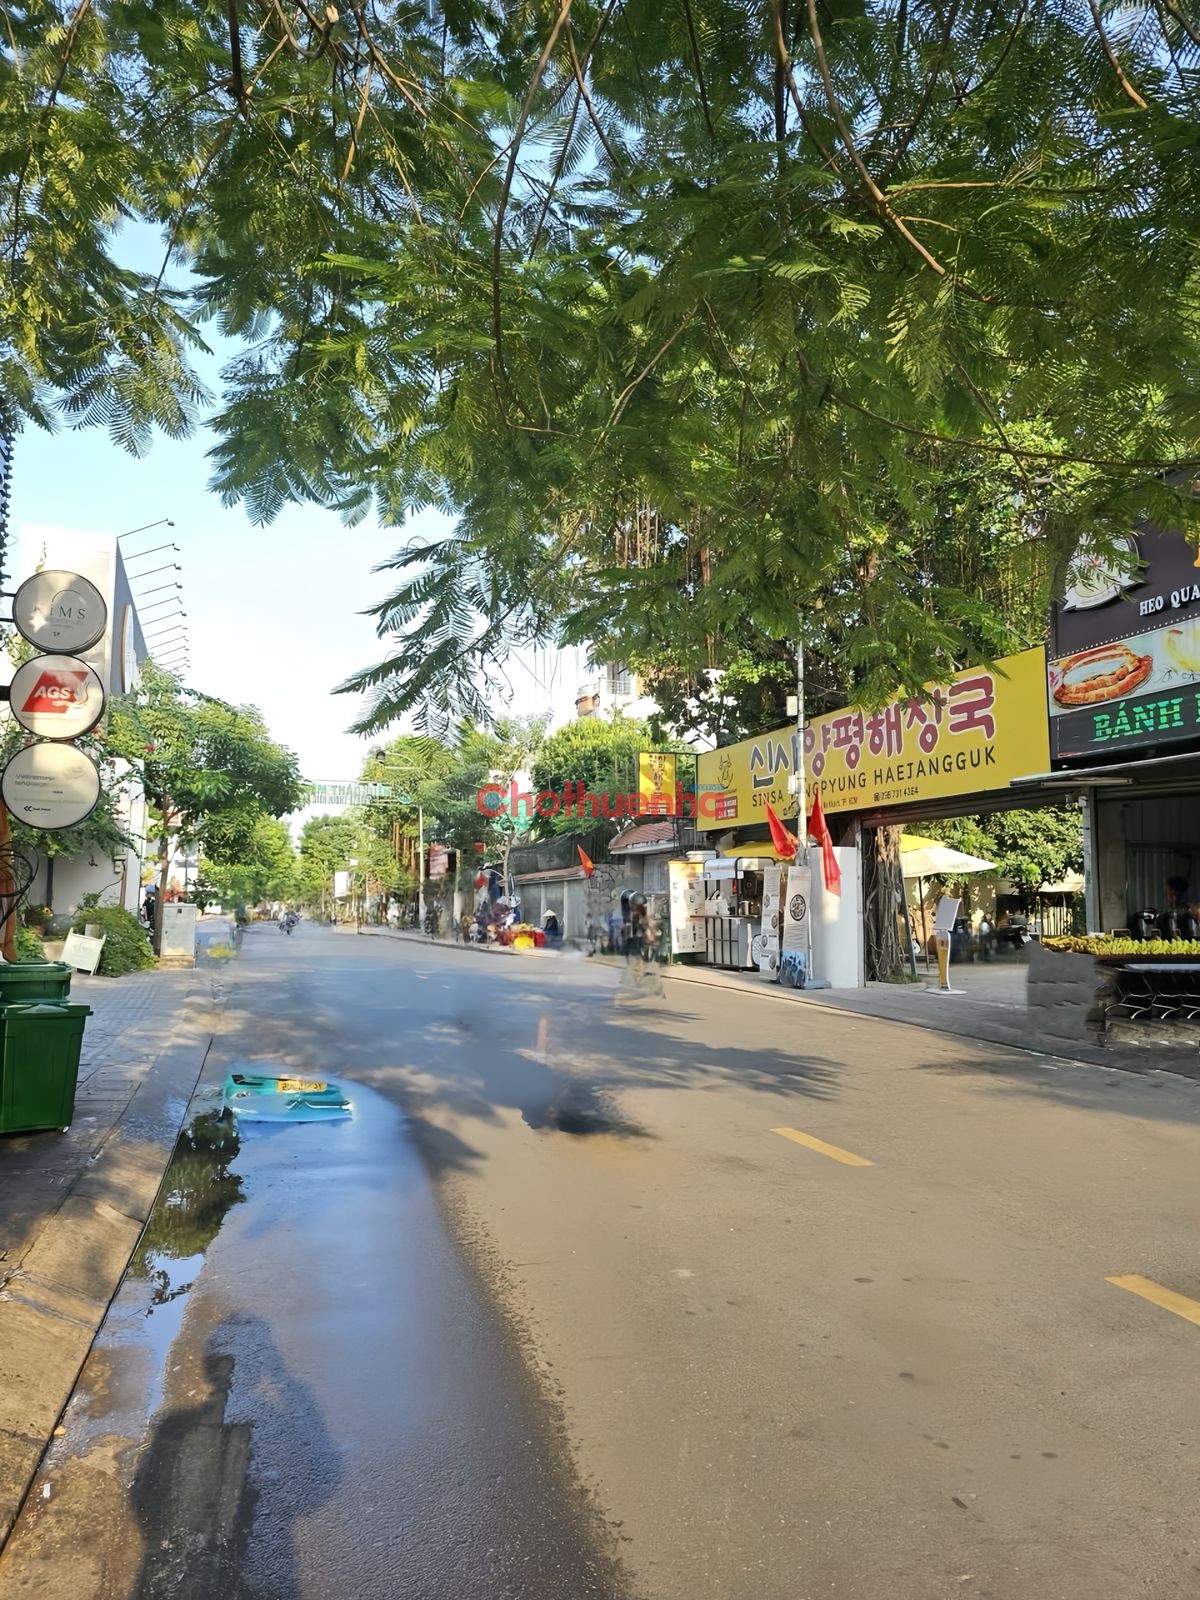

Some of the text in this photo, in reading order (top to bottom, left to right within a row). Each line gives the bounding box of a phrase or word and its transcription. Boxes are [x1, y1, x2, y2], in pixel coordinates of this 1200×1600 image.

[1139, 595, 1164, 616] HEO
[33, 685, 72, 700] AGS
[1091, 699, 1184, 742] BÁNH
[752, 790, 784, 807] SINSA
[874, 745, 996, 785] HAEJANGGUK
